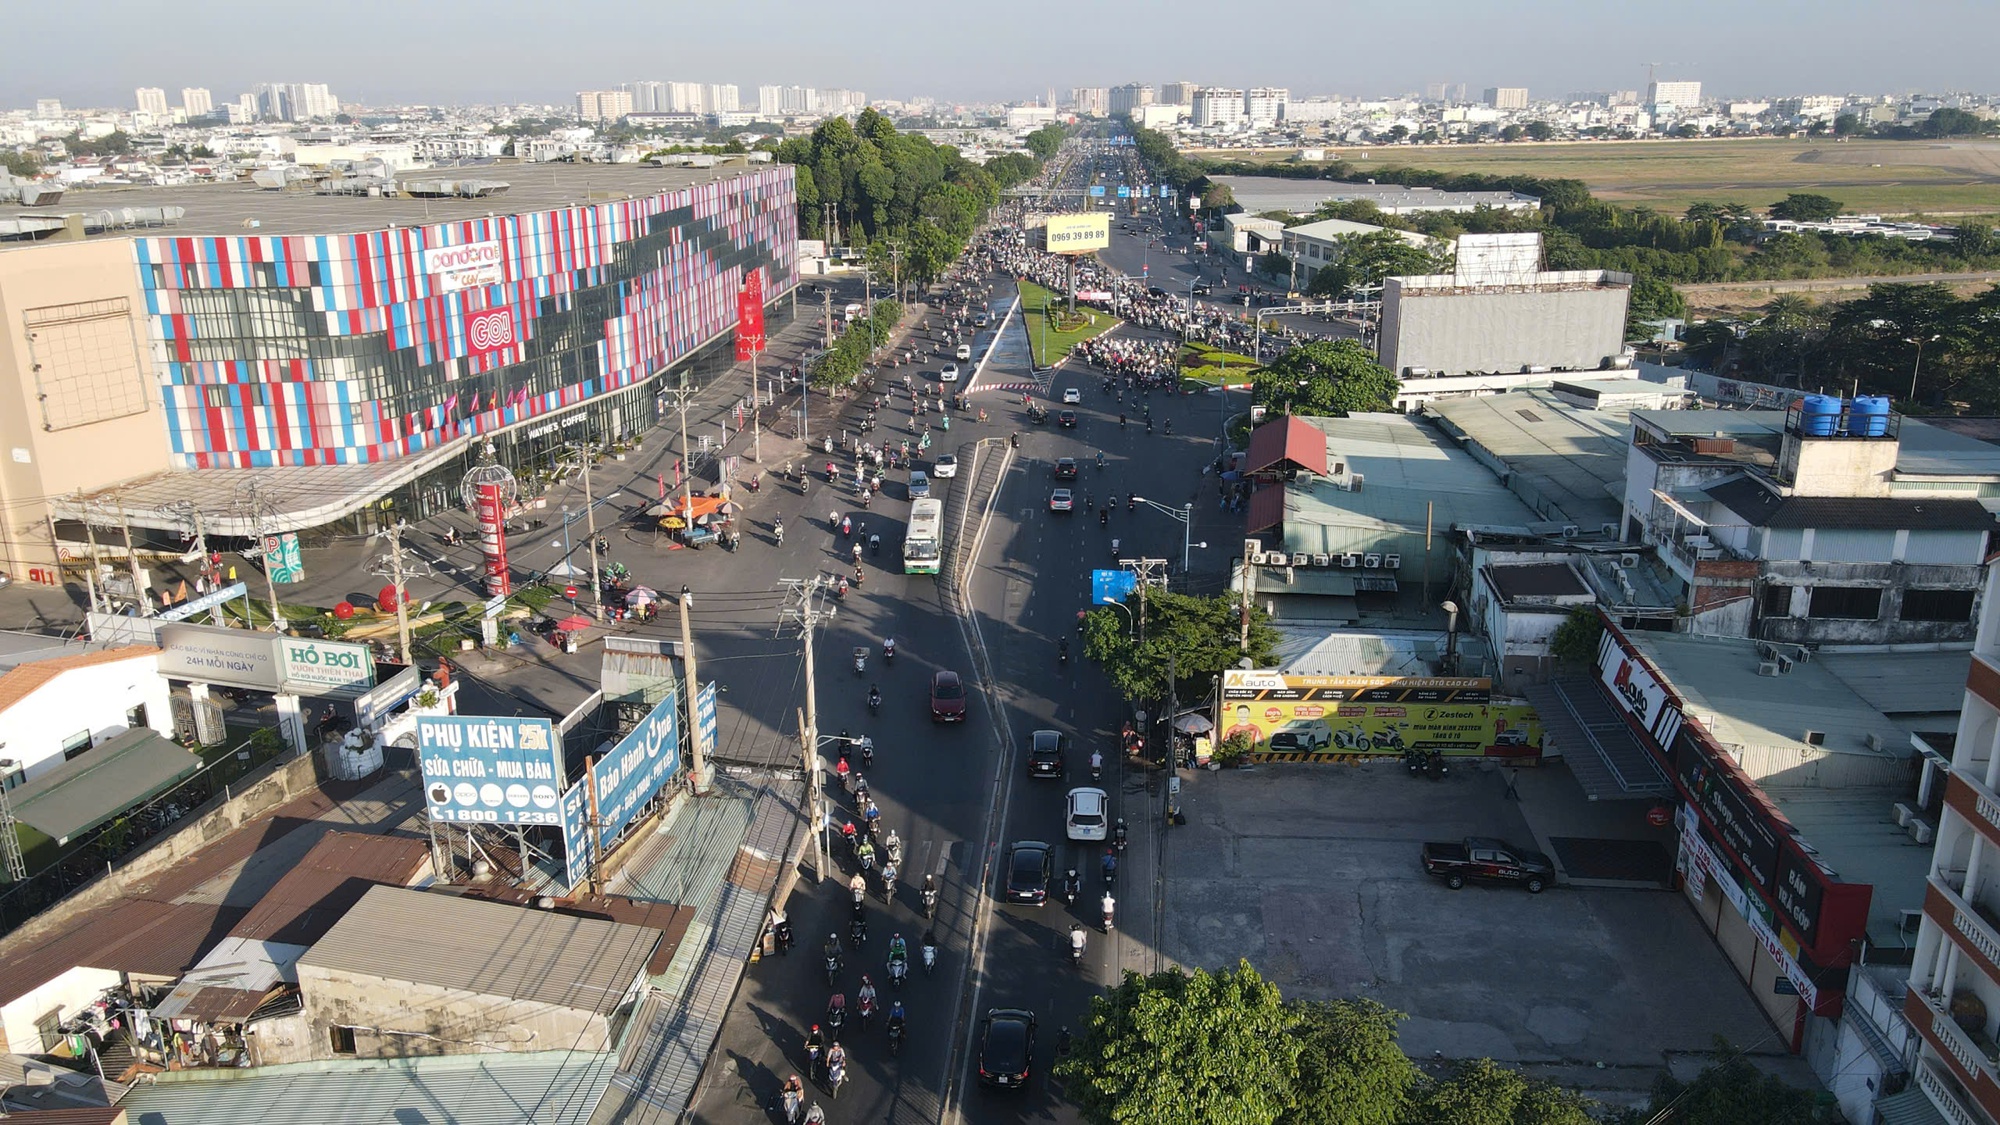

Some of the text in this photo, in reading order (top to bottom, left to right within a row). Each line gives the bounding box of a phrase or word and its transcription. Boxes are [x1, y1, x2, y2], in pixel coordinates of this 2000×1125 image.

[1051, 229, 1105, 242] 0969 39 89 89
[432, 246, 494, 271] pandora
[471, 311, 512, 350] GO!
[528, 412, 587, 440] WAYNE'S COFFEE
[186, 656, 204, 666] 24H
[227, 660, 255, 672] NGÀY
[289, 644, 361, 669] HỒ BƠI
[1245, 679, 1276, 687] auto
[1409, 679, 1428, 687] KIỆN
[1463, 679, 1479, 687] CẤP
[1628, 682, 1648, 712] auto
[1439, 711, 1474, 719] Zestech
[421, 723, 462, 752] PHỤ
[467, 720, 515, 753] KIỆN
[424, 754, 450, 777] SỬA
[453, 756, 486, 778] CHỮA
[496, 760, 524, 779] MUA
[525, 759, 552, 779] BÁN
[600, 767, 619, 801] Bảo
[621, 740, 645, 779] Hành
[445, 809, 559, 823] 1800 1236
[1788, 868, 1807, 898] BÁN
[1793, 905, 1811, 931] GÓP
